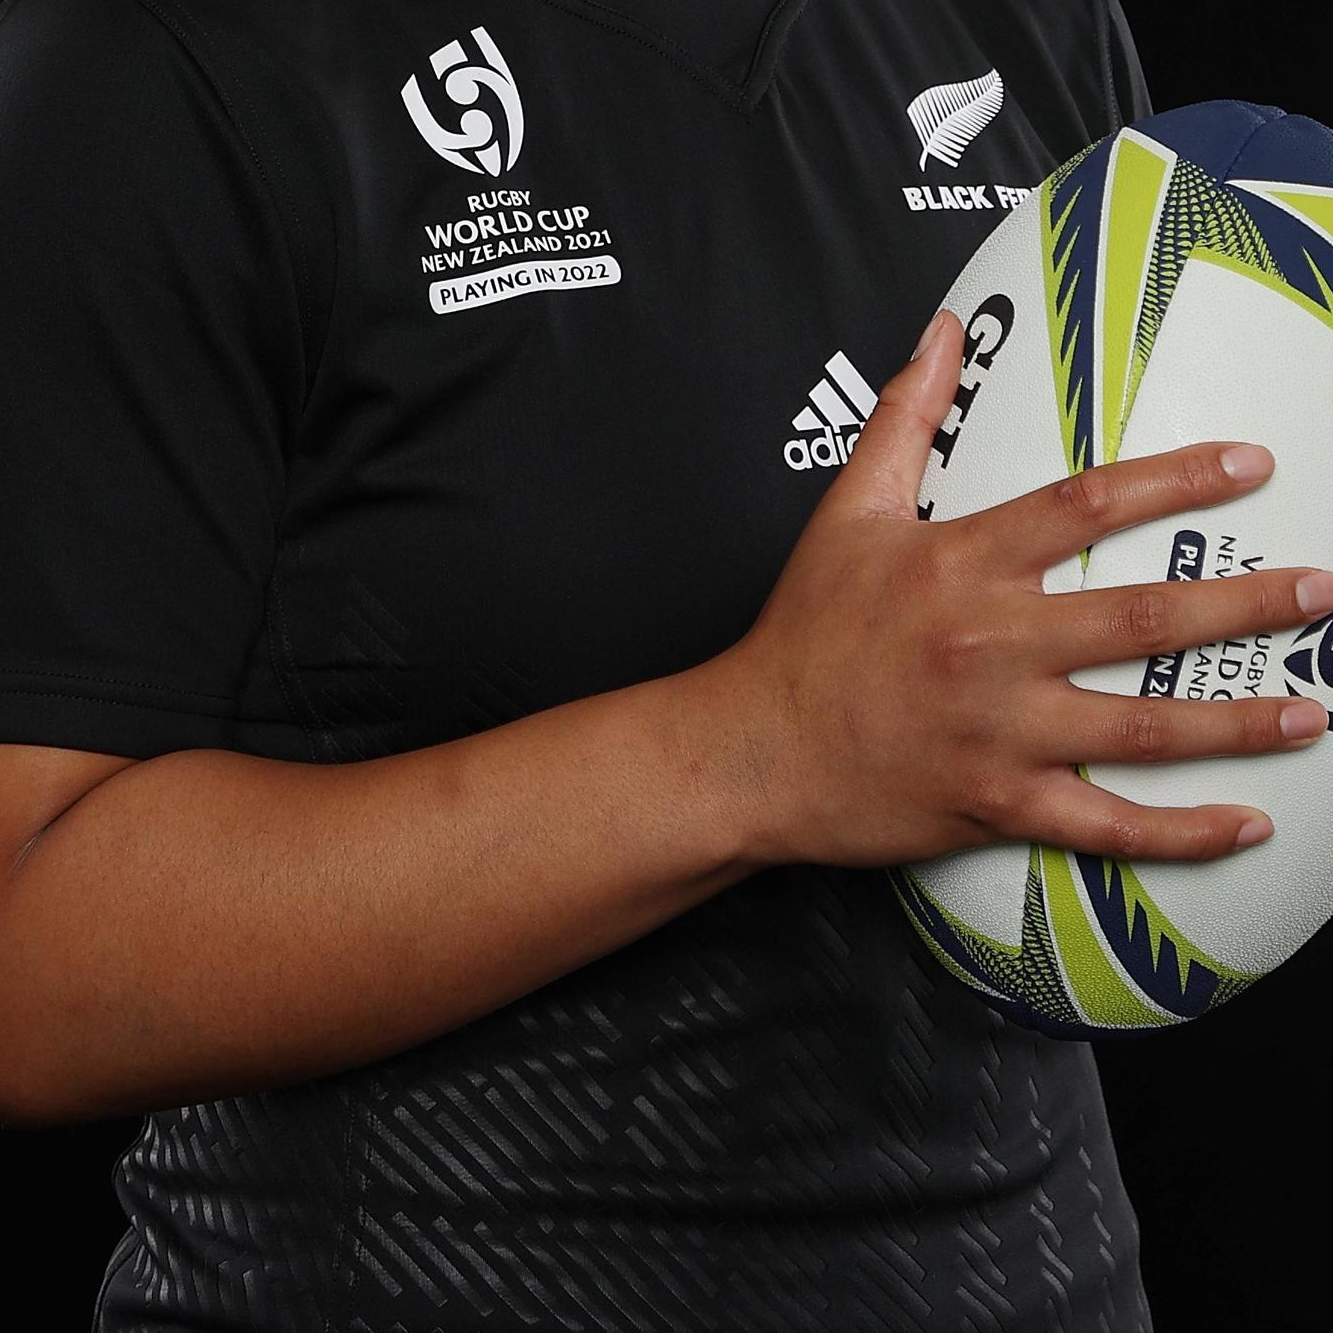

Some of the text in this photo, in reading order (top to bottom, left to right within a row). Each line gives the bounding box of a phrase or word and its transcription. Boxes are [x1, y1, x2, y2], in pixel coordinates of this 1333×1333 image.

[467, 190, 531, 213] RUGBY
[902, 184, 995, 211] BLACK
[424, 205, 590, 249] WORLD CUP
[421, 229, 612, 274] NEW ZEALAND 2021
[439, 263, 610, 306] PLAYING IN 2022
[783, 421, 865, 471] adi
[1245, 634, 1272, 698] UGBY
